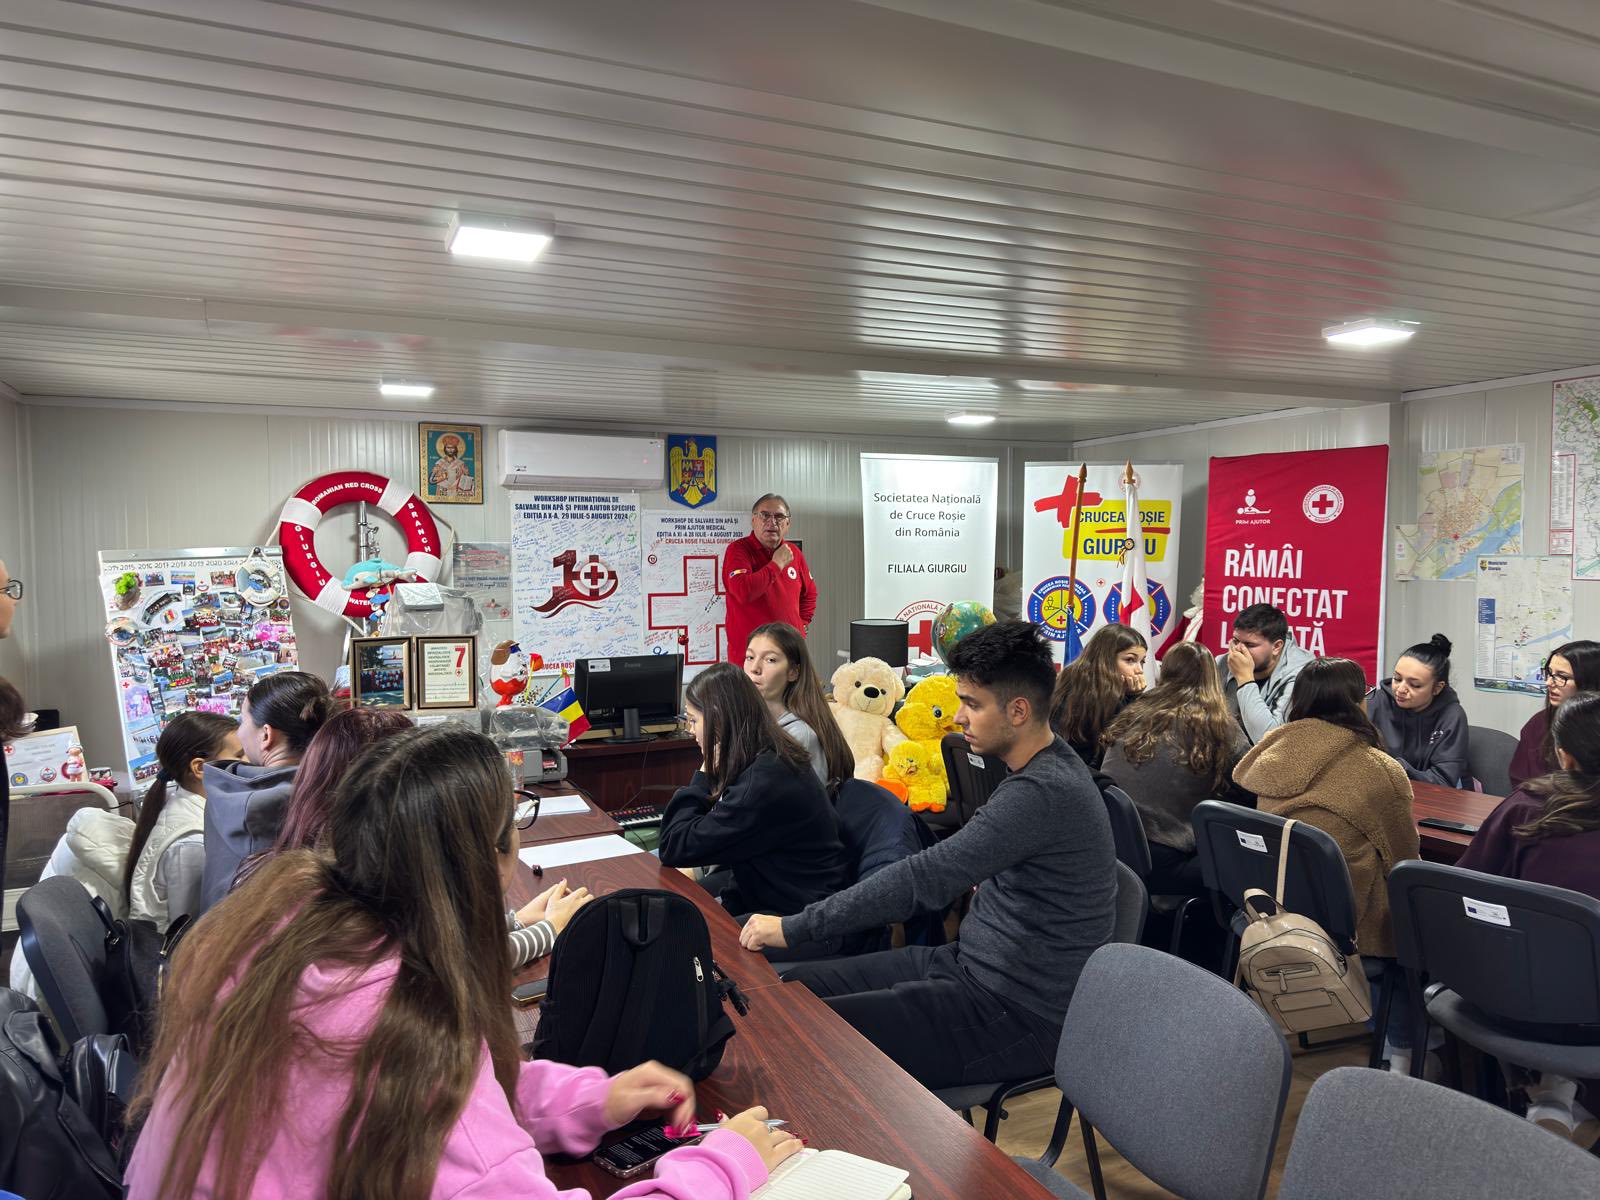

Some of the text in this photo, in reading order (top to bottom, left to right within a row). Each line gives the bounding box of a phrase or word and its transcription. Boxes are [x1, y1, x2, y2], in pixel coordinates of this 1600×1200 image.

[311, 483, 344, 505] ROMANIAN
[360, 482, 383, 494] CROSS
[533, 495, 568, 503] WORKSHOP
[568, 495, 611, 504] INTERNAȚIONAL
[873, 492, 981, 506] Societatea Națională
[514, 503, 540, 511] SALVARE
[541, 503, 552, 511] DIN
[552, 502, 564, 511] APĂ
[611, 504, 636, 512] SPECIFIC
[523, 512, 543, 520] EDIȚIA
[614, 512, 628, 520] 2024
[889, 509, 966, 523] de Cruce Roșie
[1080, 511, 1165, 526] CRUCEA OȘIE
[407, 502, 432, 553] BRANCH
[895, 527, 960, 538] din România
[1083, 538, 1157, 555] GIURU
[294, 525, 326, 586] GIURGIU
[1224, 543, 1303, 579] RĂMÂI
[887, 563, 967, 574] FILIALA GIURGIU
[1222, 585, 1348, 619] CONECTAT
[455, 647, 466, 668] 7
[560, 662, 575, 670] ROȘI
